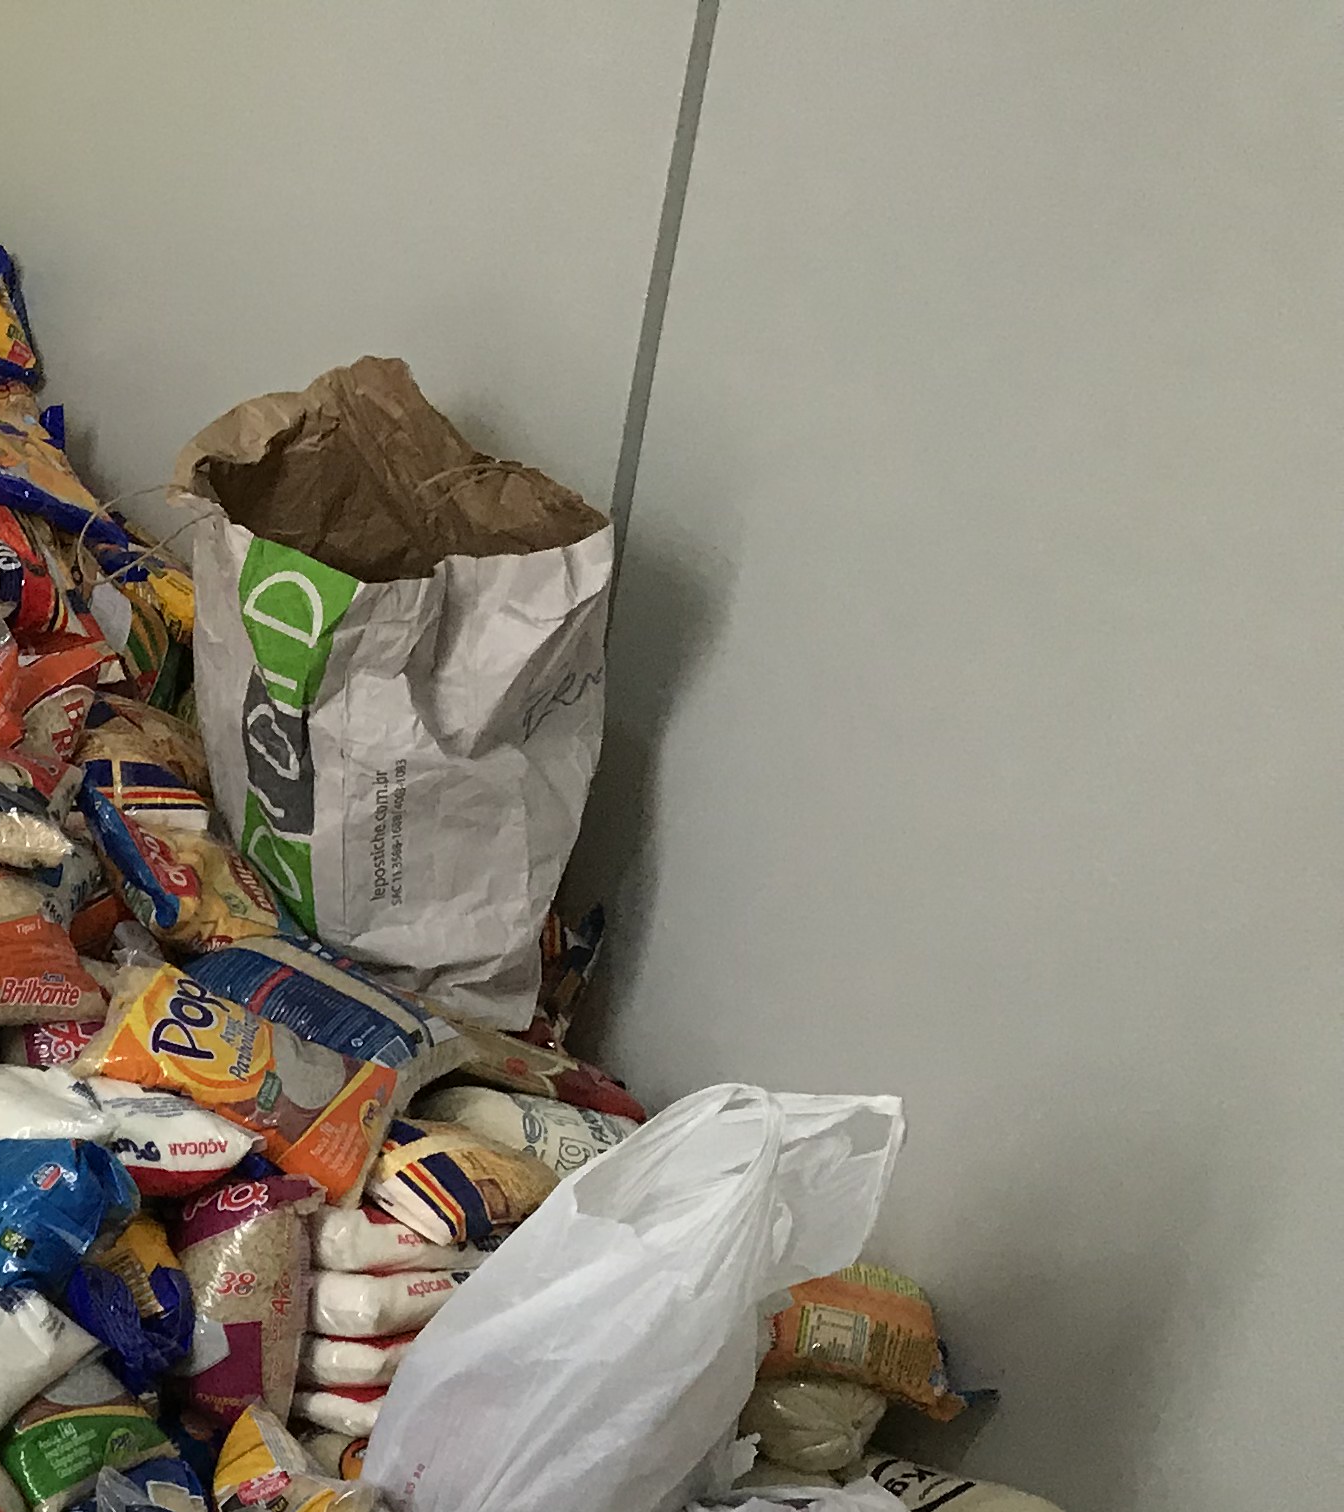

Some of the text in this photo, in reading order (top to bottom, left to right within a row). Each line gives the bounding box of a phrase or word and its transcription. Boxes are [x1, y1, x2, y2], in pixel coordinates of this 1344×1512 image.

[370, 770, 388, 901] lepostiche.com.br
[392, 884, 402, 906] SAC
[0, 978, 80, 1006] Brilhante
[151, 976, 233, 1061] Pop
[168, 1140, 229, 1156] AÇÚCAR
[397, 1233, 426, 1246] AÇÚ
[217, 1271, 256, 1296] 38
[406, 1275, 454, 1297] AÇÚCAR
